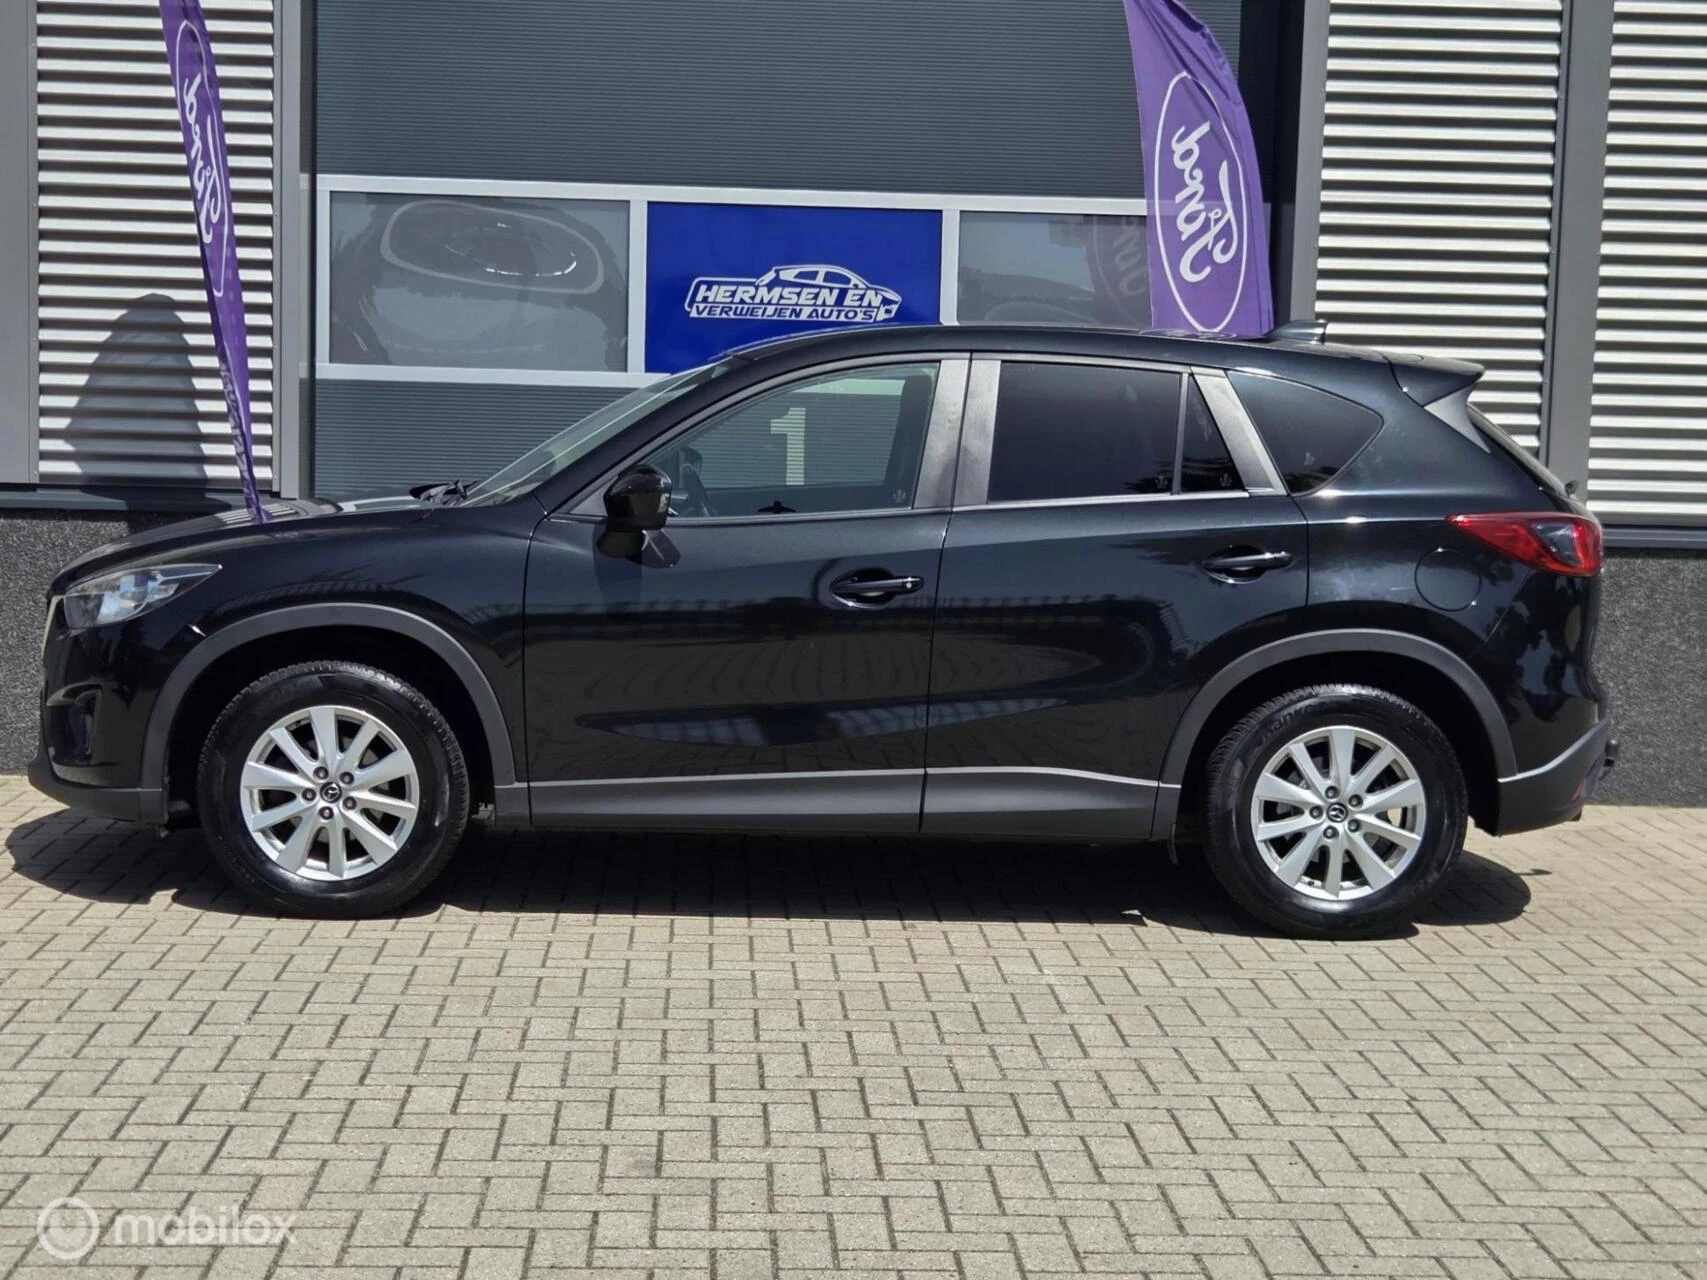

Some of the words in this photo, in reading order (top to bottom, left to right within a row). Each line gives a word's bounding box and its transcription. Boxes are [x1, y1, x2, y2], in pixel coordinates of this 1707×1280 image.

[695, 285, 840, 306] HERMSEN
[843, 288, 883, 307] EN
[695, 305, 803, 319] VERWEIJEN
[807, 308, 874, 321] AUTO'S
[770, 407, 806, 485] 1
